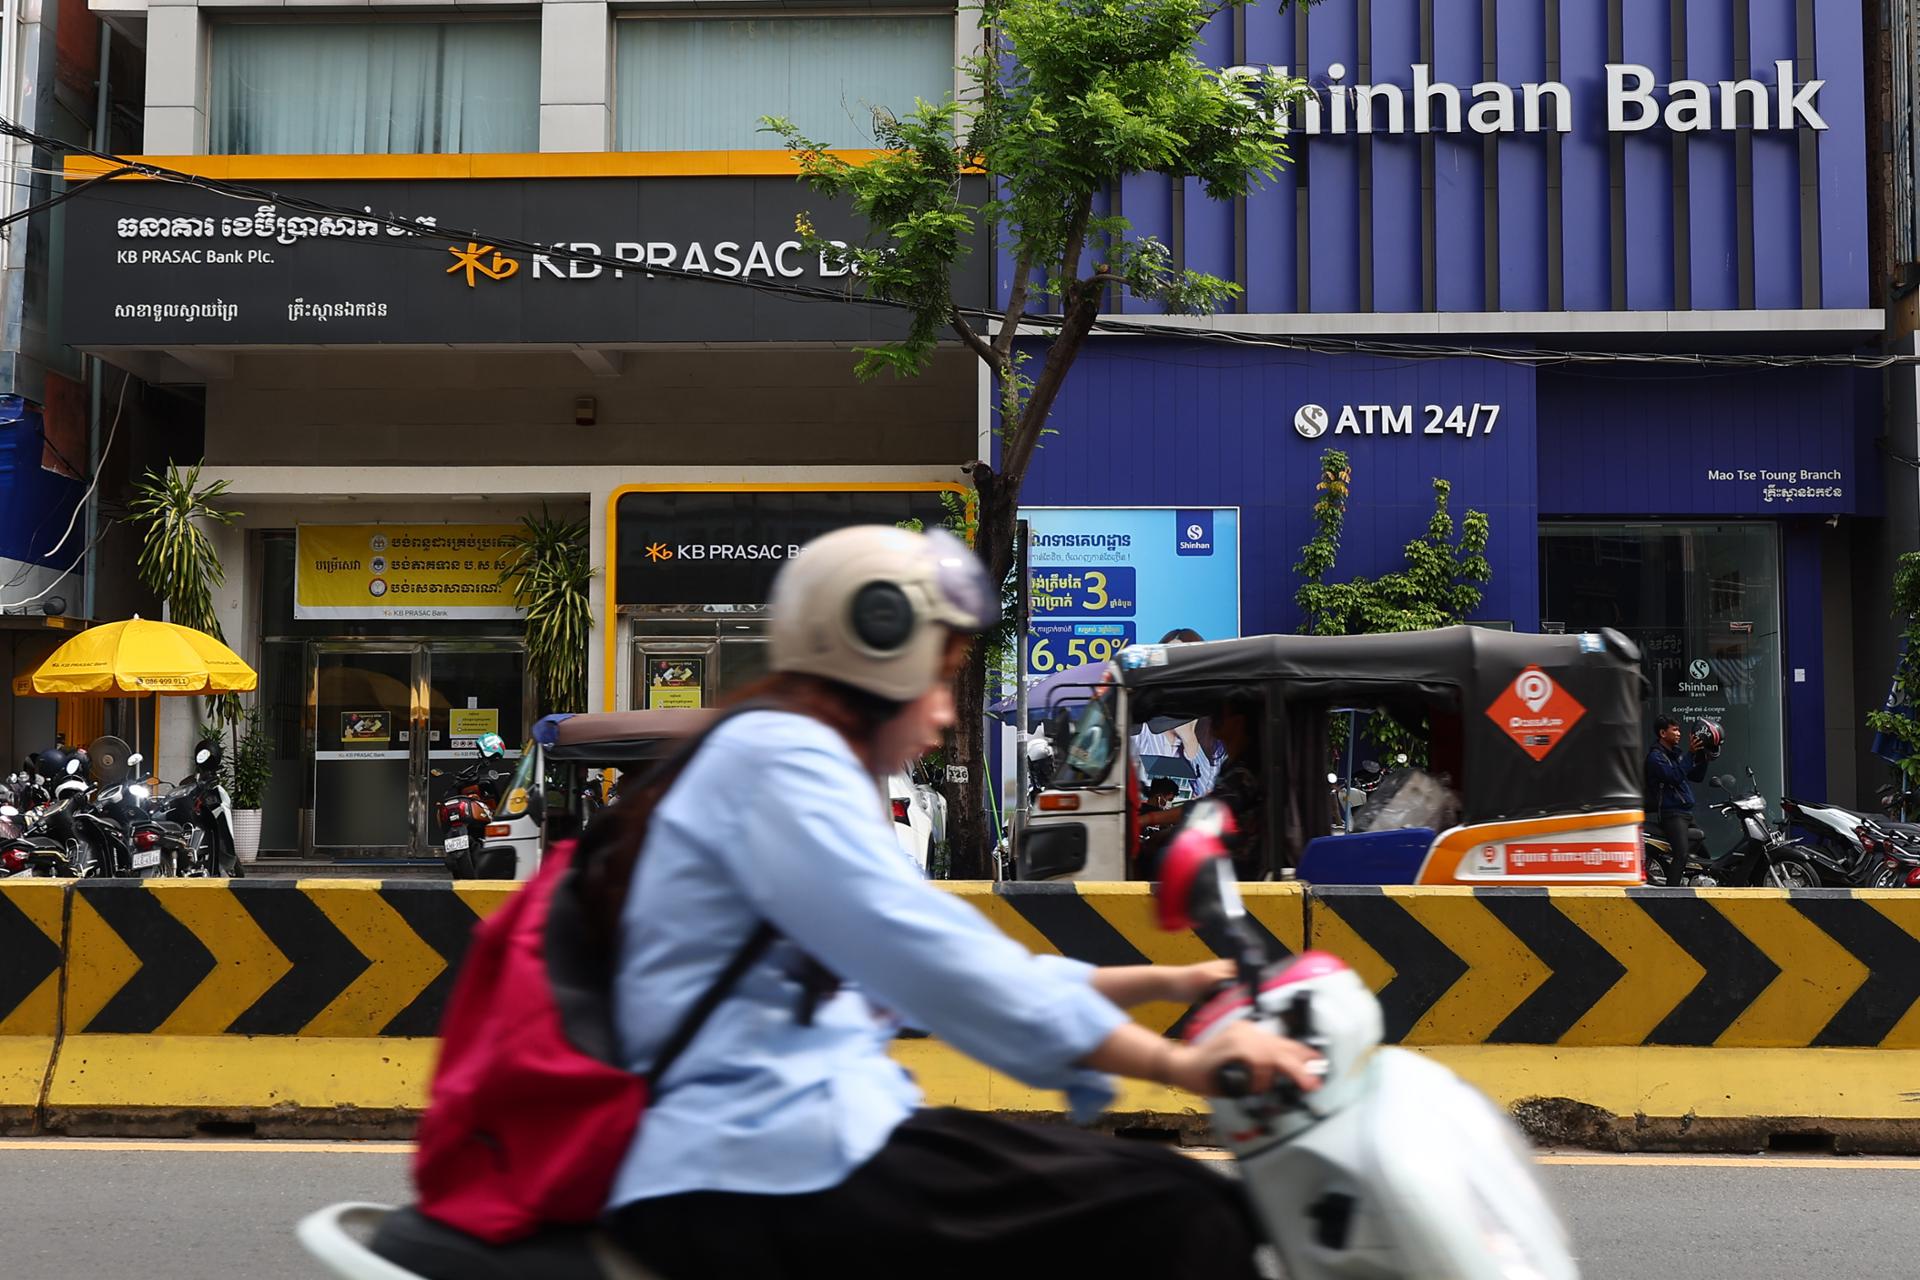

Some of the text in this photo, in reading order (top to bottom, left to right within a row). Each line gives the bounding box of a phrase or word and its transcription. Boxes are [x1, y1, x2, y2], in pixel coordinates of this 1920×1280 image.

[1604, 59, 1829, 132] Bank
[117, 216, 216, 238] ធនាគារ
[117, 250, 275, 264] KB PRASAC Bank Plc.
[532, 242, 602, 279] KB
[615, 240, 805, 279] PRASAC
[1334, 403, 1500, 438] ATM 24/7
[1708, 469, 1841, 484] Mao Tse Toung Branch
[1032, 534, 1131, 551] ណទានគេហដ្ឋាន
[1180, 541, 1210, 550] Shinhan
[677, 544, 706, 560] KB
[709, 544, 782, 560] PRASAC
[1082, 571, 1109, 610] 3
[1678, 682, 1719, 692] Shinhan
